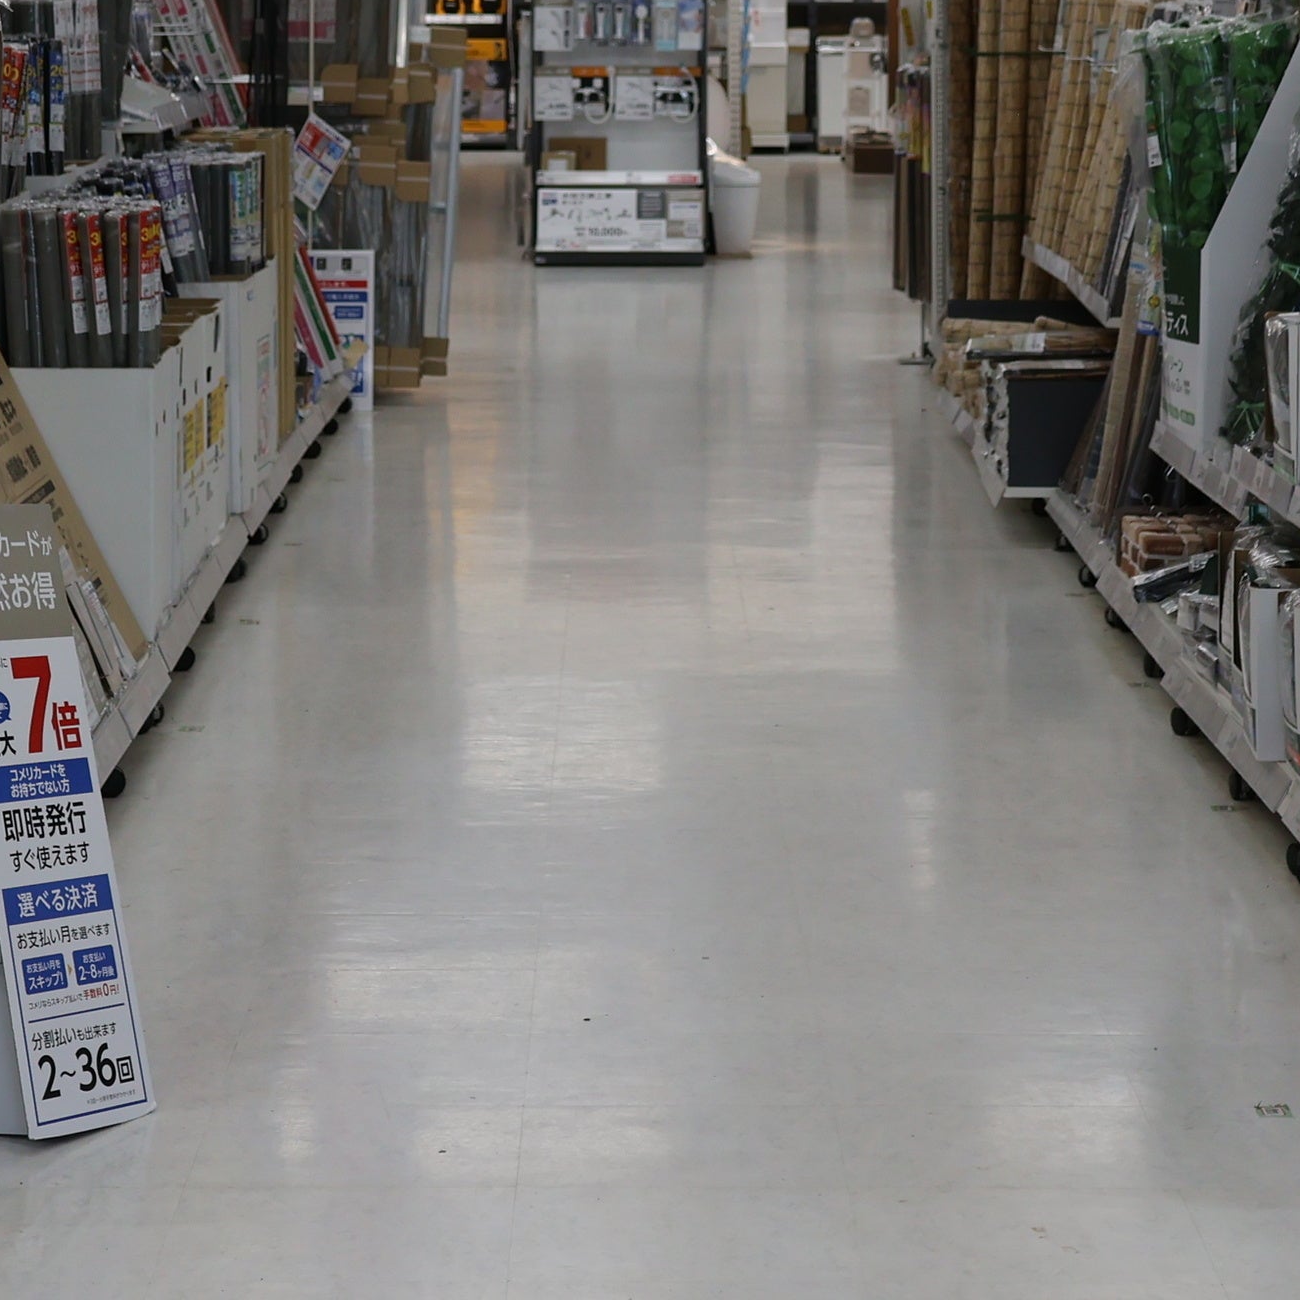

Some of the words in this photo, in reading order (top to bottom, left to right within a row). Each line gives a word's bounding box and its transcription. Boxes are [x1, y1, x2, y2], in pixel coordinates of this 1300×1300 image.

[2, 801, 87, 842] 即時発行
[10, 841, 90, 873] すぐ使えます
[18, 883, 99, 918] 選べる決済
